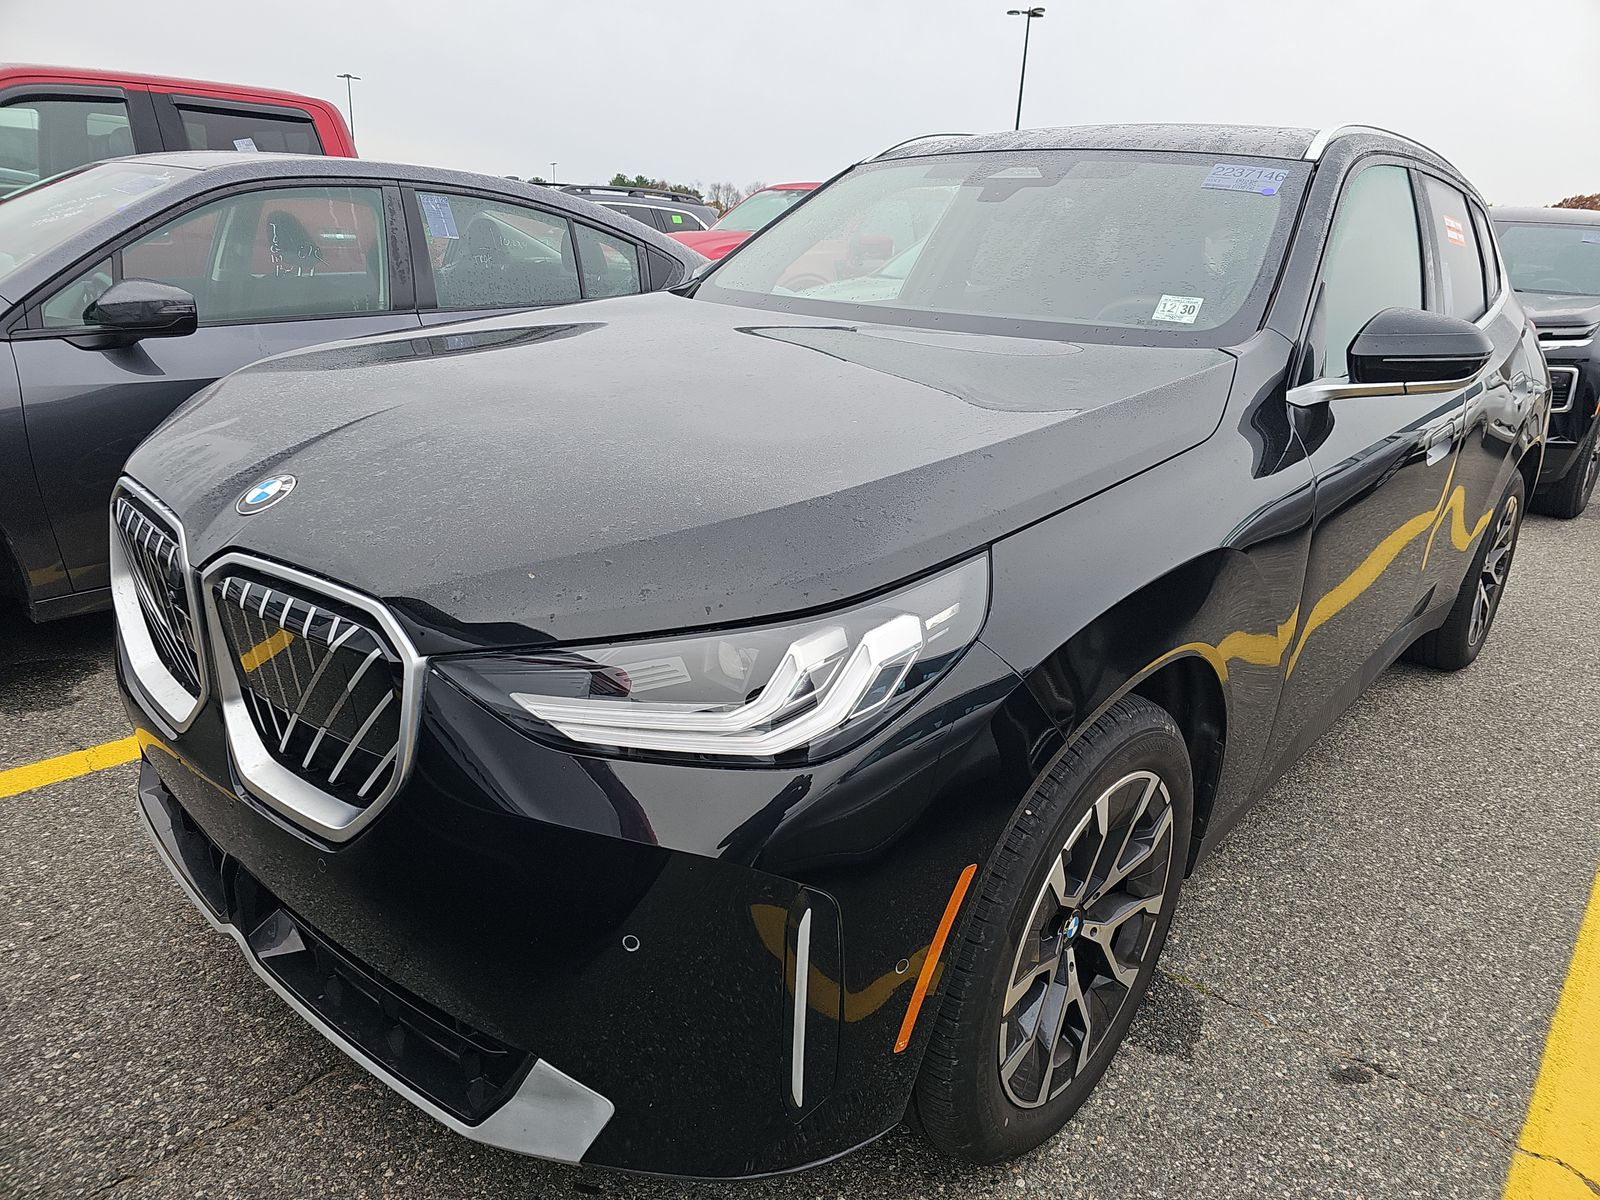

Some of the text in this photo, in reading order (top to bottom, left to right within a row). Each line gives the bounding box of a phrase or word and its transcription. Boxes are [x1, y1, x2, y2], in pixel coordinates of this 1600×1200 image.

[1212, 166, 1287, 182] 2237146
[1160, 302, 1196, 315] 12 30
